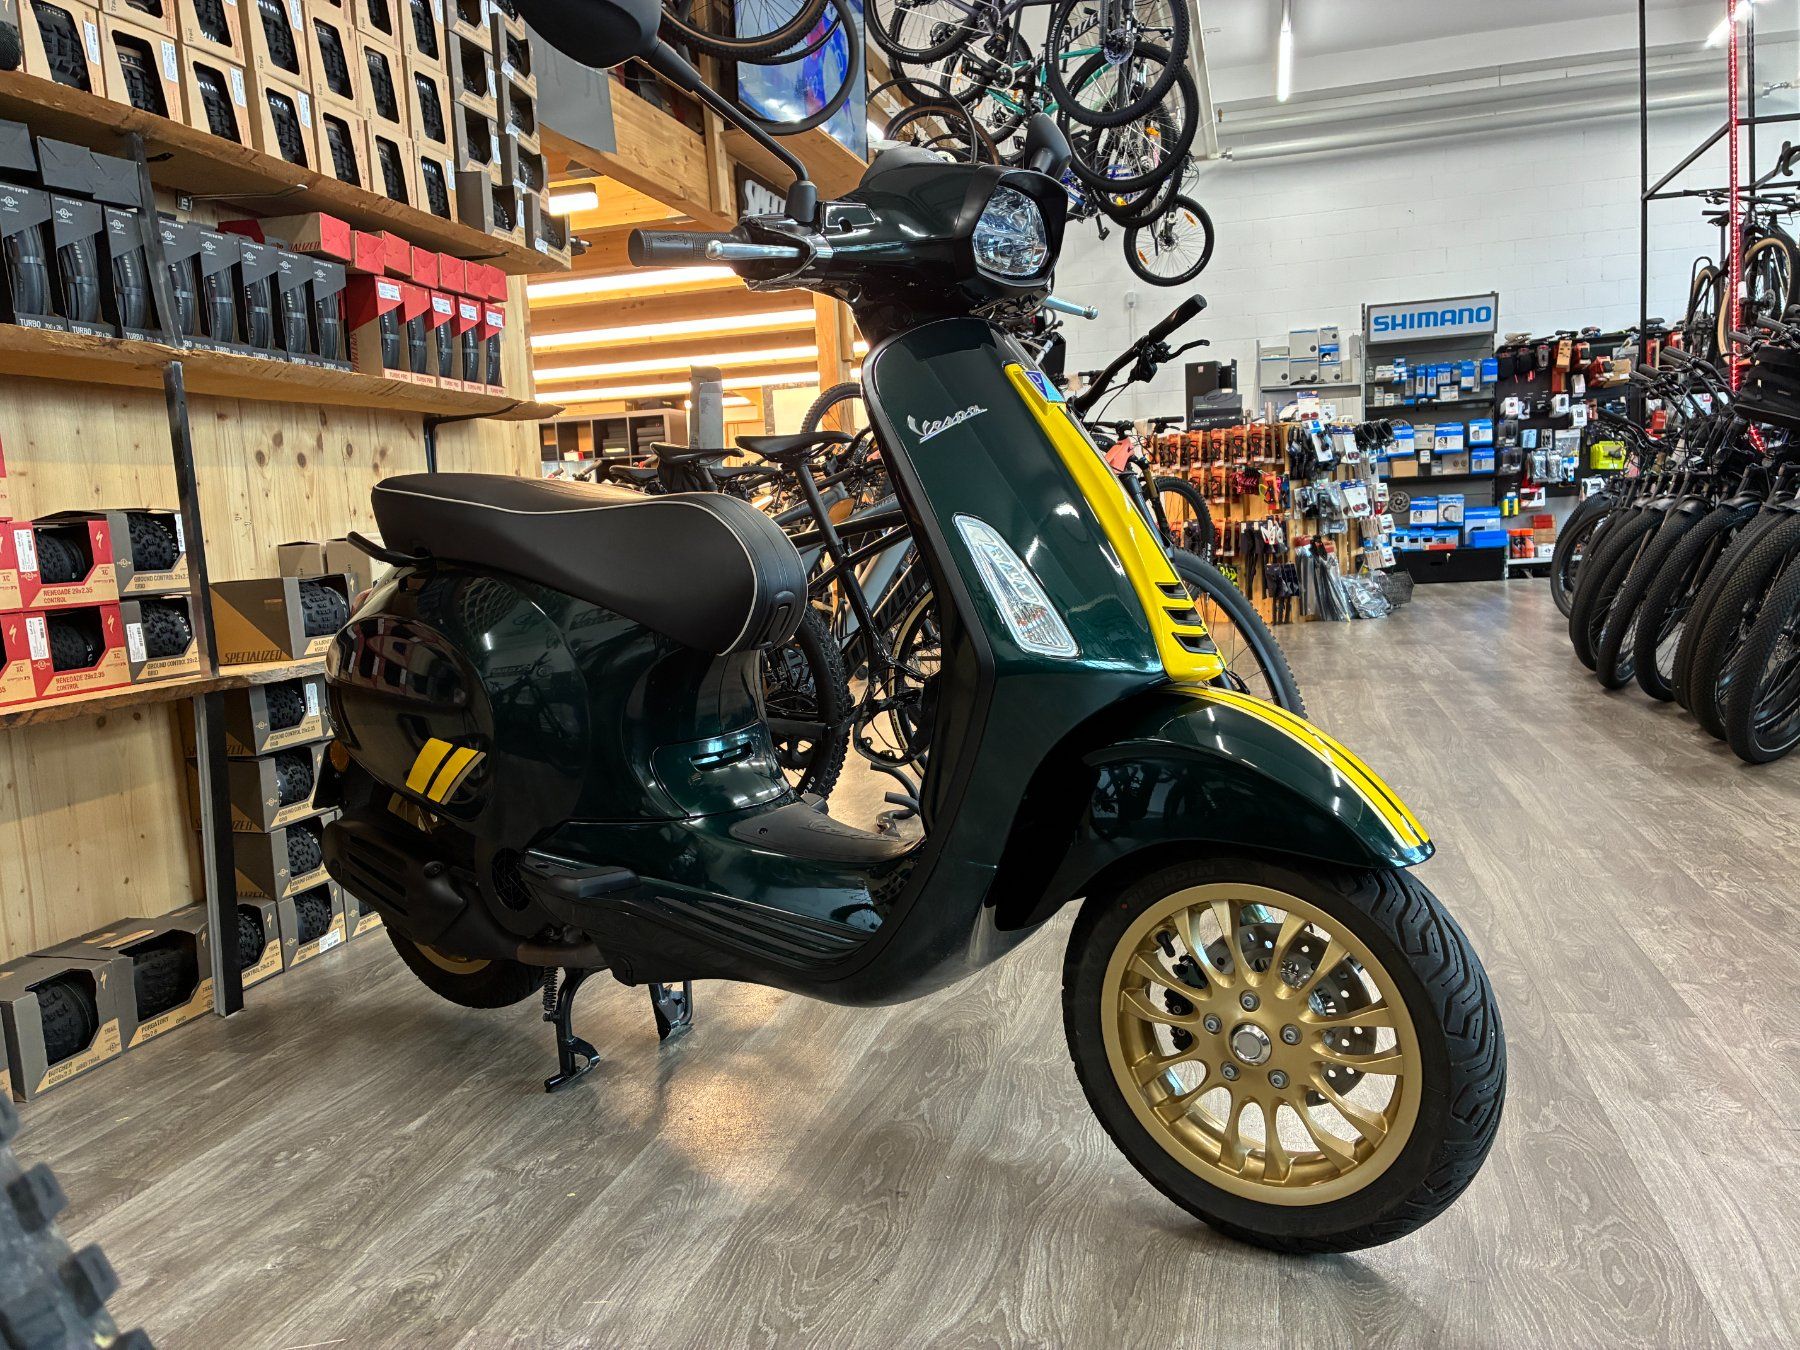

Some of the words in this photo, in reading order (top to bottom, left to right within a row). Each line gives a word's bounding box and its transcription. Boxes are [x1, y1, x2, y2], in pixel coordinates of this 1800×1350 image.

[20, 318, 41, 329] TURBO
[1373, 306, 1492, 332] SHIMANO
[72, 325, 92, 335] TURBO
[126, 332, 144, 341] TURBO
[215, 346, 230, 354] TURBO
[907, 405, 988, 444] Vespa
[43, 588, 70, 597] RENEGADE
[225, 649, 283, 662] SPECIALIZED
[56, 675, 83, 683] RENEGADE
[56, 684, 79, 692] CONTROL
[243, 968, 259, 980] CONTROL
[104, 1024, 117, 1034] TRAIL
[141, 1016, 169, 1033] PURGATORY
[48, 1061, 73, 1078] BUTCHER
